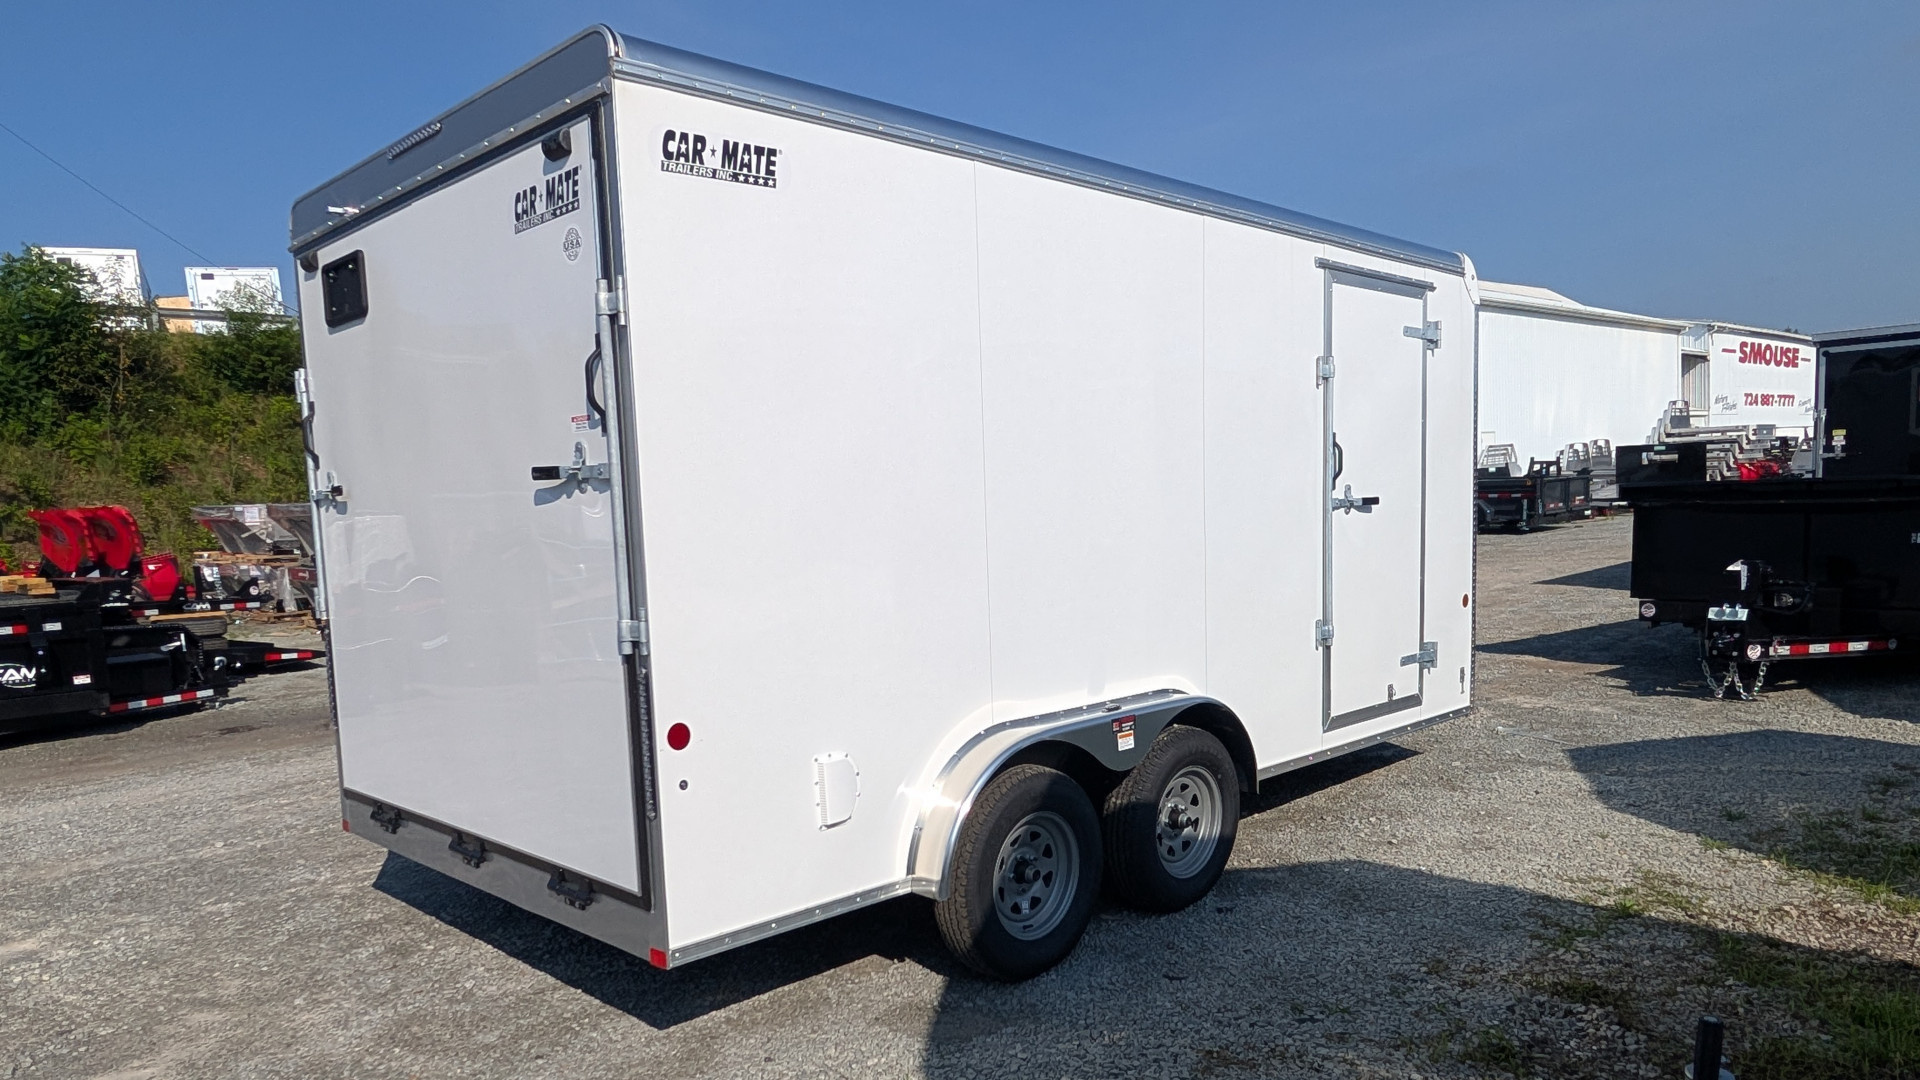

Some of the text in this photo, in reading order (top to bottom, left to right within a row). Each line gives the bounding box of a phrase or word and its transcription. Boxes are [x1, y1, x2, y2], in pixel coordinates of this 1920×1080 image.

[662, 129, 778, 177] CAR MATE
[662, 161, 736, 182] TRAILERS INC.
[514, 165, 579, 223] CAR MATE
[563, 239, 581, 251] USA
[1738, 341, 1800, 368] SMOUSE
[1744, 393, 1759, 407] 724
